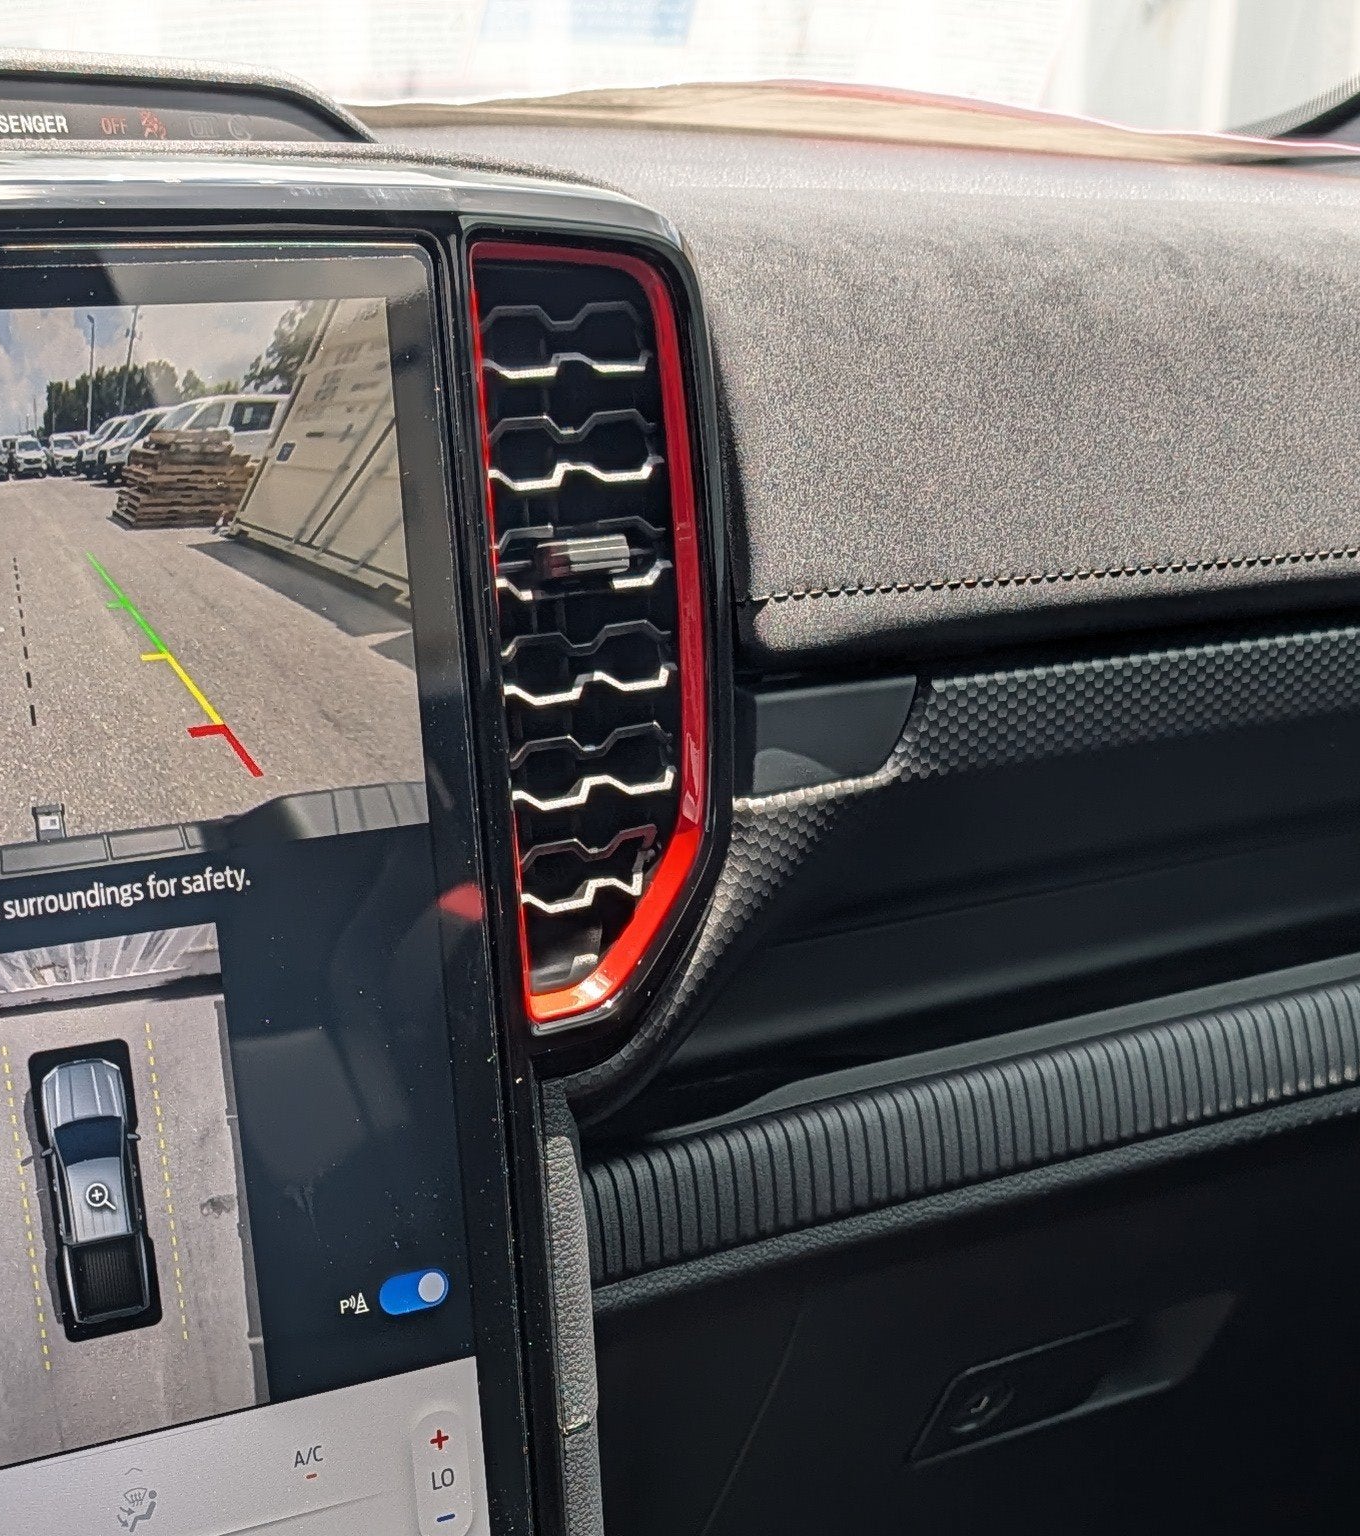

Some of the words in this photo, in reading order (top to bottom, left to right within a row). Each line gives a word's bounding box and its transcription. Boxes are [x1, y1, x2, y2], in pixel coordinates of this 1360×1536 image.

[101, 116, 128, 135] OFF
[4, 881, 144, 919] surroundings
[146, 871, 178, 899] for
[181, 865, 251, 896] safety.
[294, 1445, 324, 1468] A/C
[431, 1468, 455, 1490] LO
